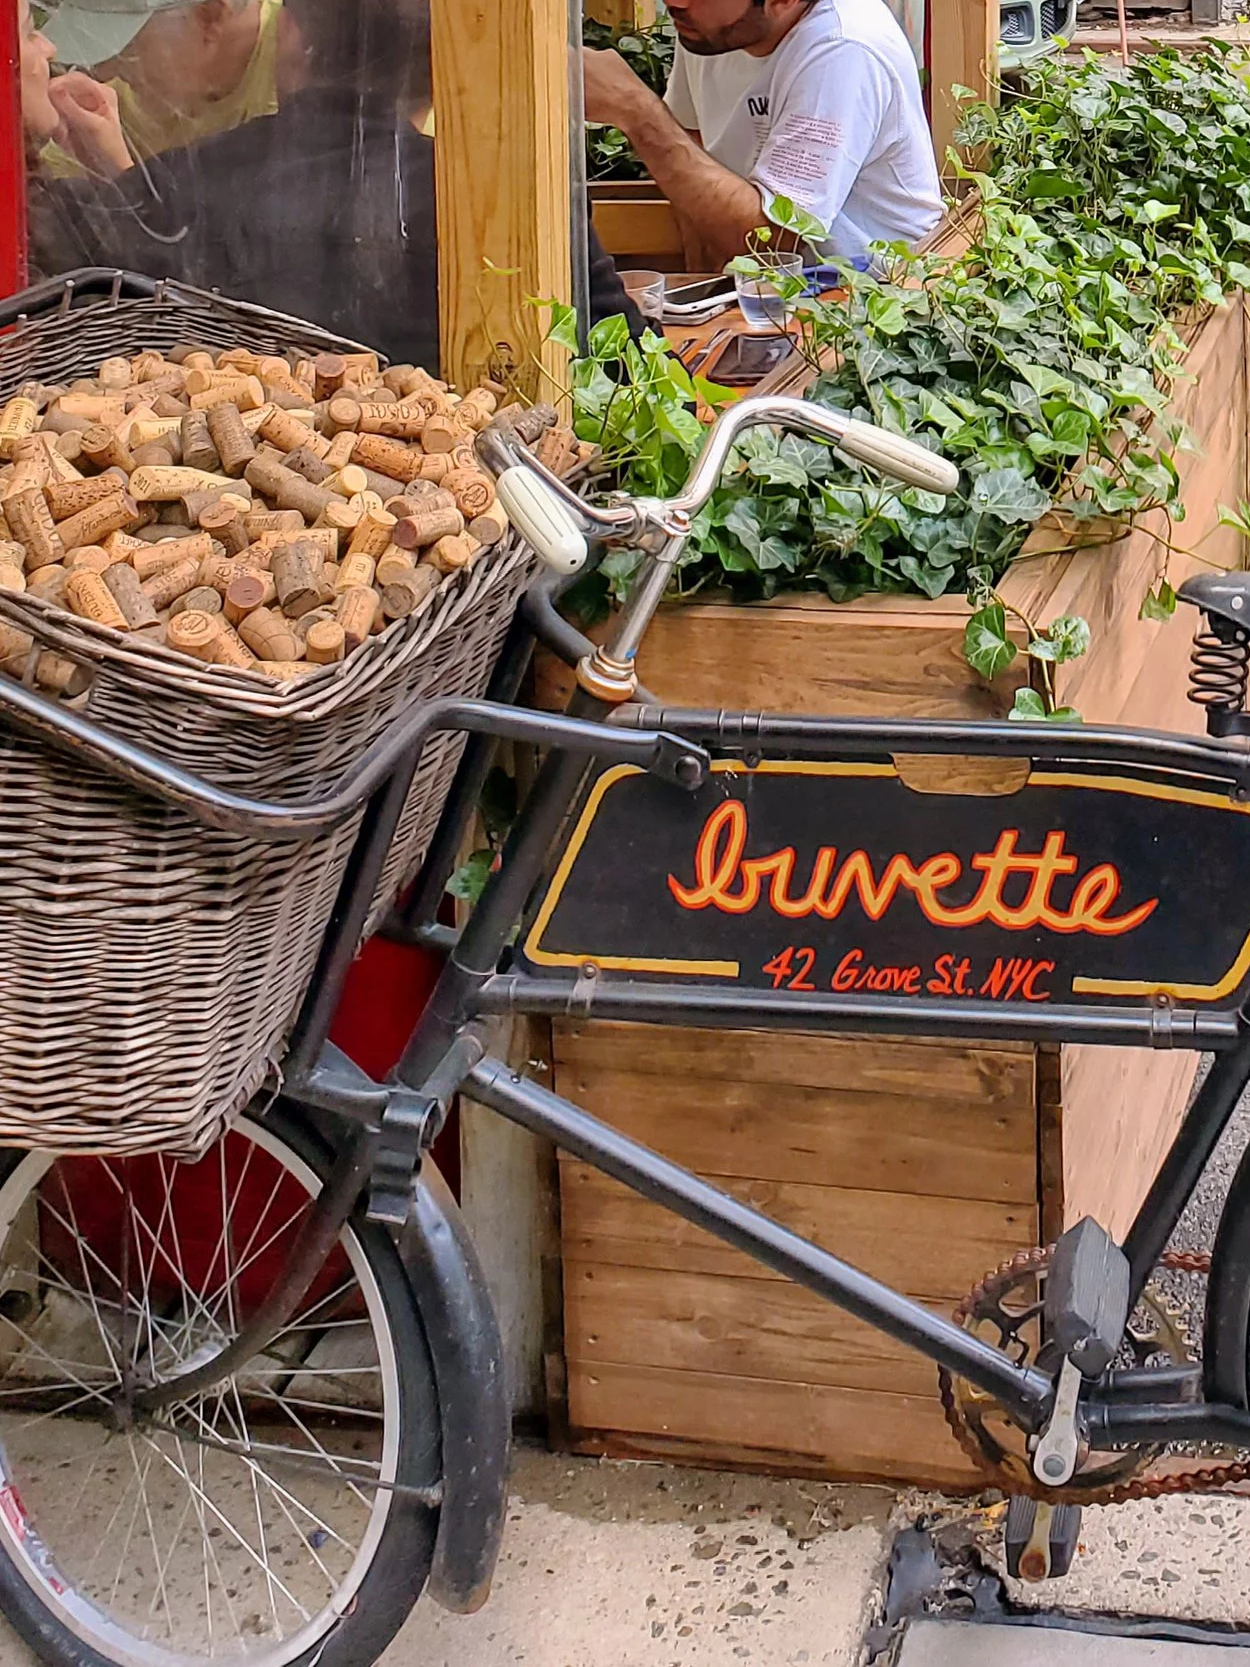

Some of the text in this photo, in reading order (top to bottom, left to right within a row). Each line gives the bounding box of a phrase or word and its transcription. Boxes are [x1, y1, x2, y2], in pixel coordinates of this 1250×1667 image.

[667, 798, 1158, 936] buvette
[763, 946, 1056, 1001] 42 Grove St. NYC
